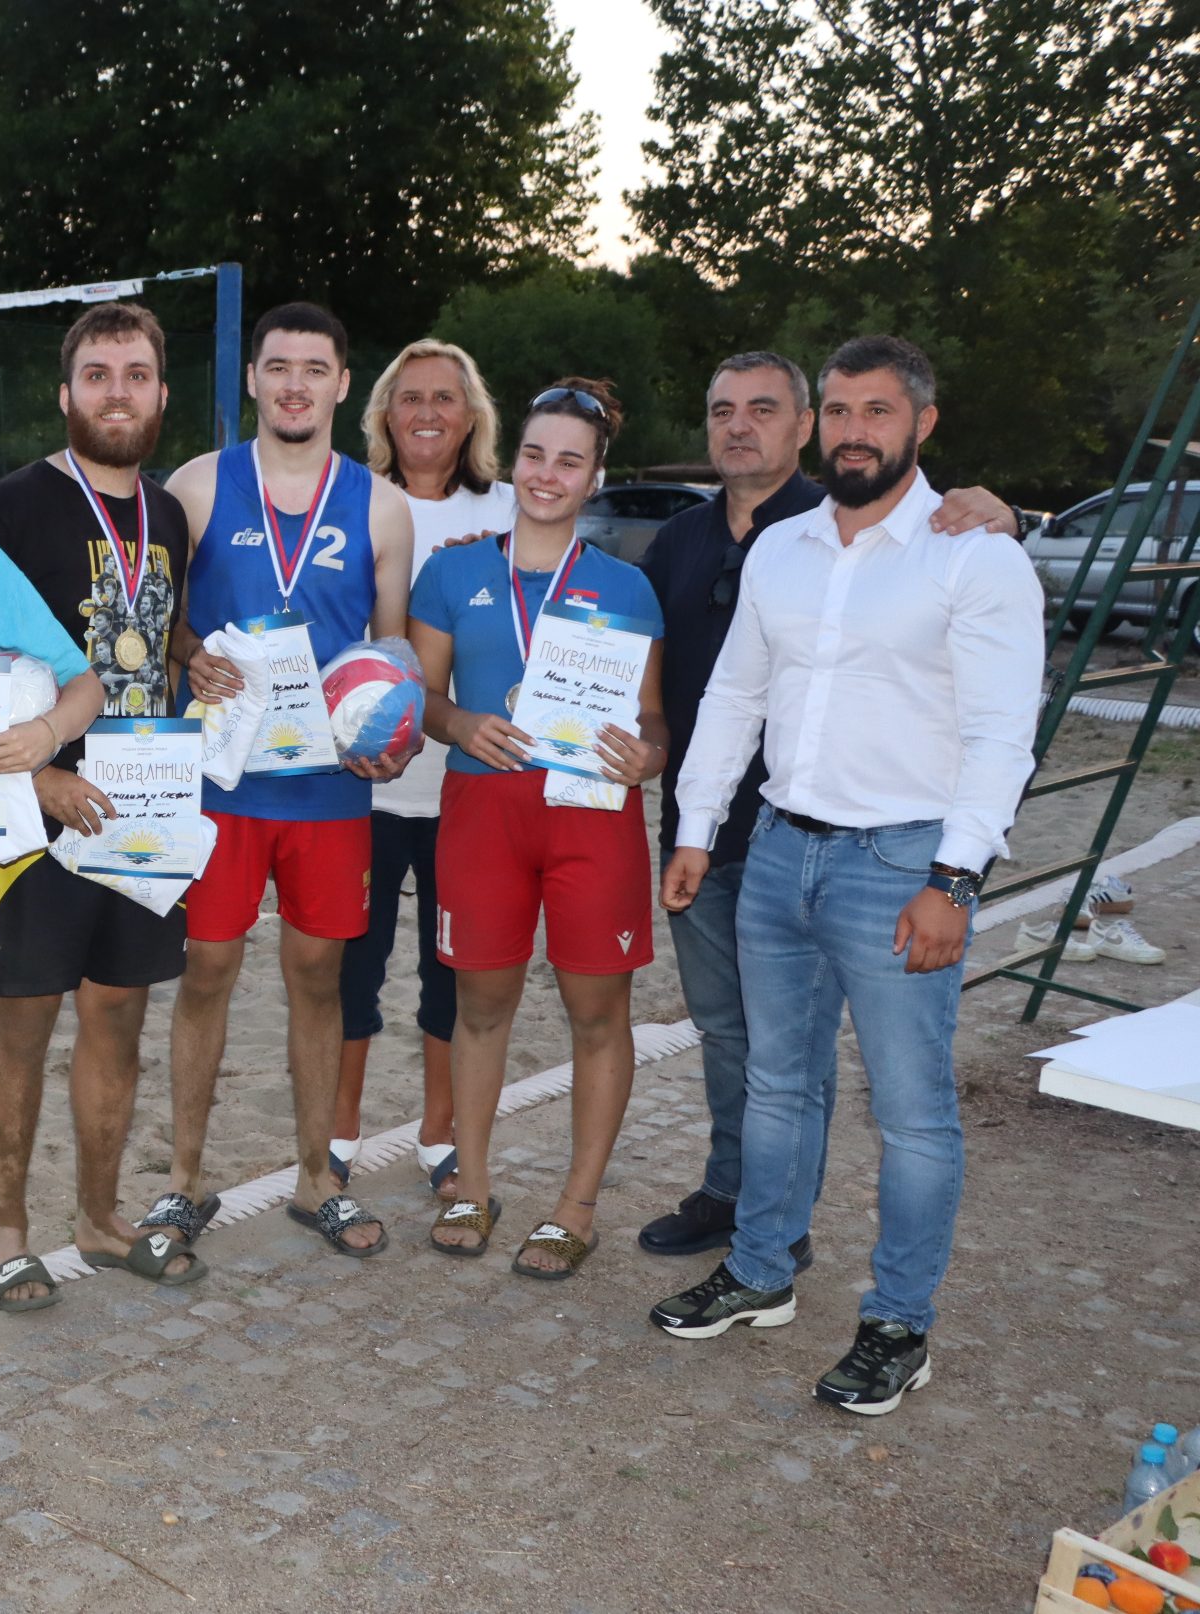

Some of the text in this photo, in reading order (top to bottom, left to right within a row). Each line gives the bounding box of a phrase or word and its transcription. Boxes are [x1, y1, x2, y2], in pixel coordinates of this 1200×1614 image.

[311, 525, 347, 571] 2
[469, 597, 495, 606] PEAK
[2, 1258, 28, 1275] NIKE
